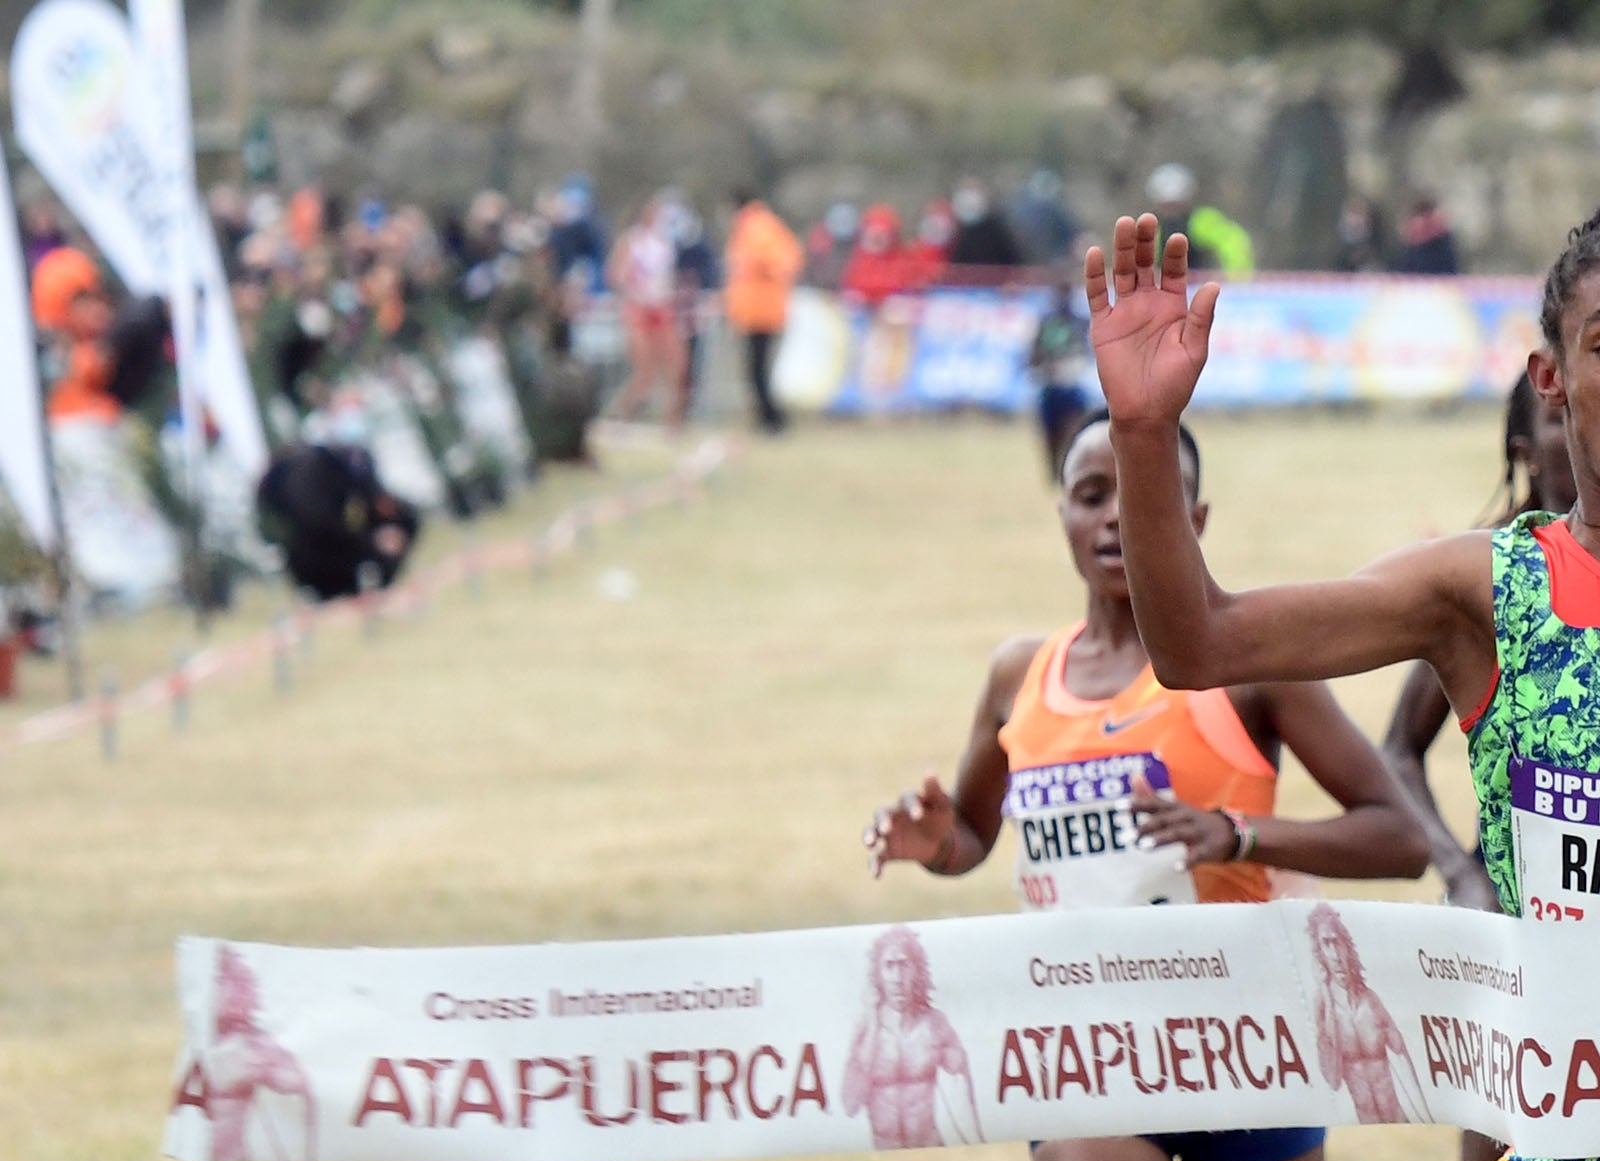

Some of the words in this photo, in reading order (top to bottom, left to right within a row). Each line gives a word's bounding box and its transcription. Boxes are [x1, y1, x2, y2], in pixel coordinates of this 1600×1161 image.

[1022, 809, 1140, 864] CHEBE
[1029, 957, 1094, 987] Cross
[1098, 949, 1230, 982] Internacional
[1418, 949, 1459, 981] Cross
[1456, 952, 1523, 997] Internacional
[426, 991, 536, 1021] Cross
[550, 979, 763, 1018] Internacional
[998, 1014, 1309, 1104] ATAPUERCA
[352, 1042, 829, 1129] ATAPUERCA
